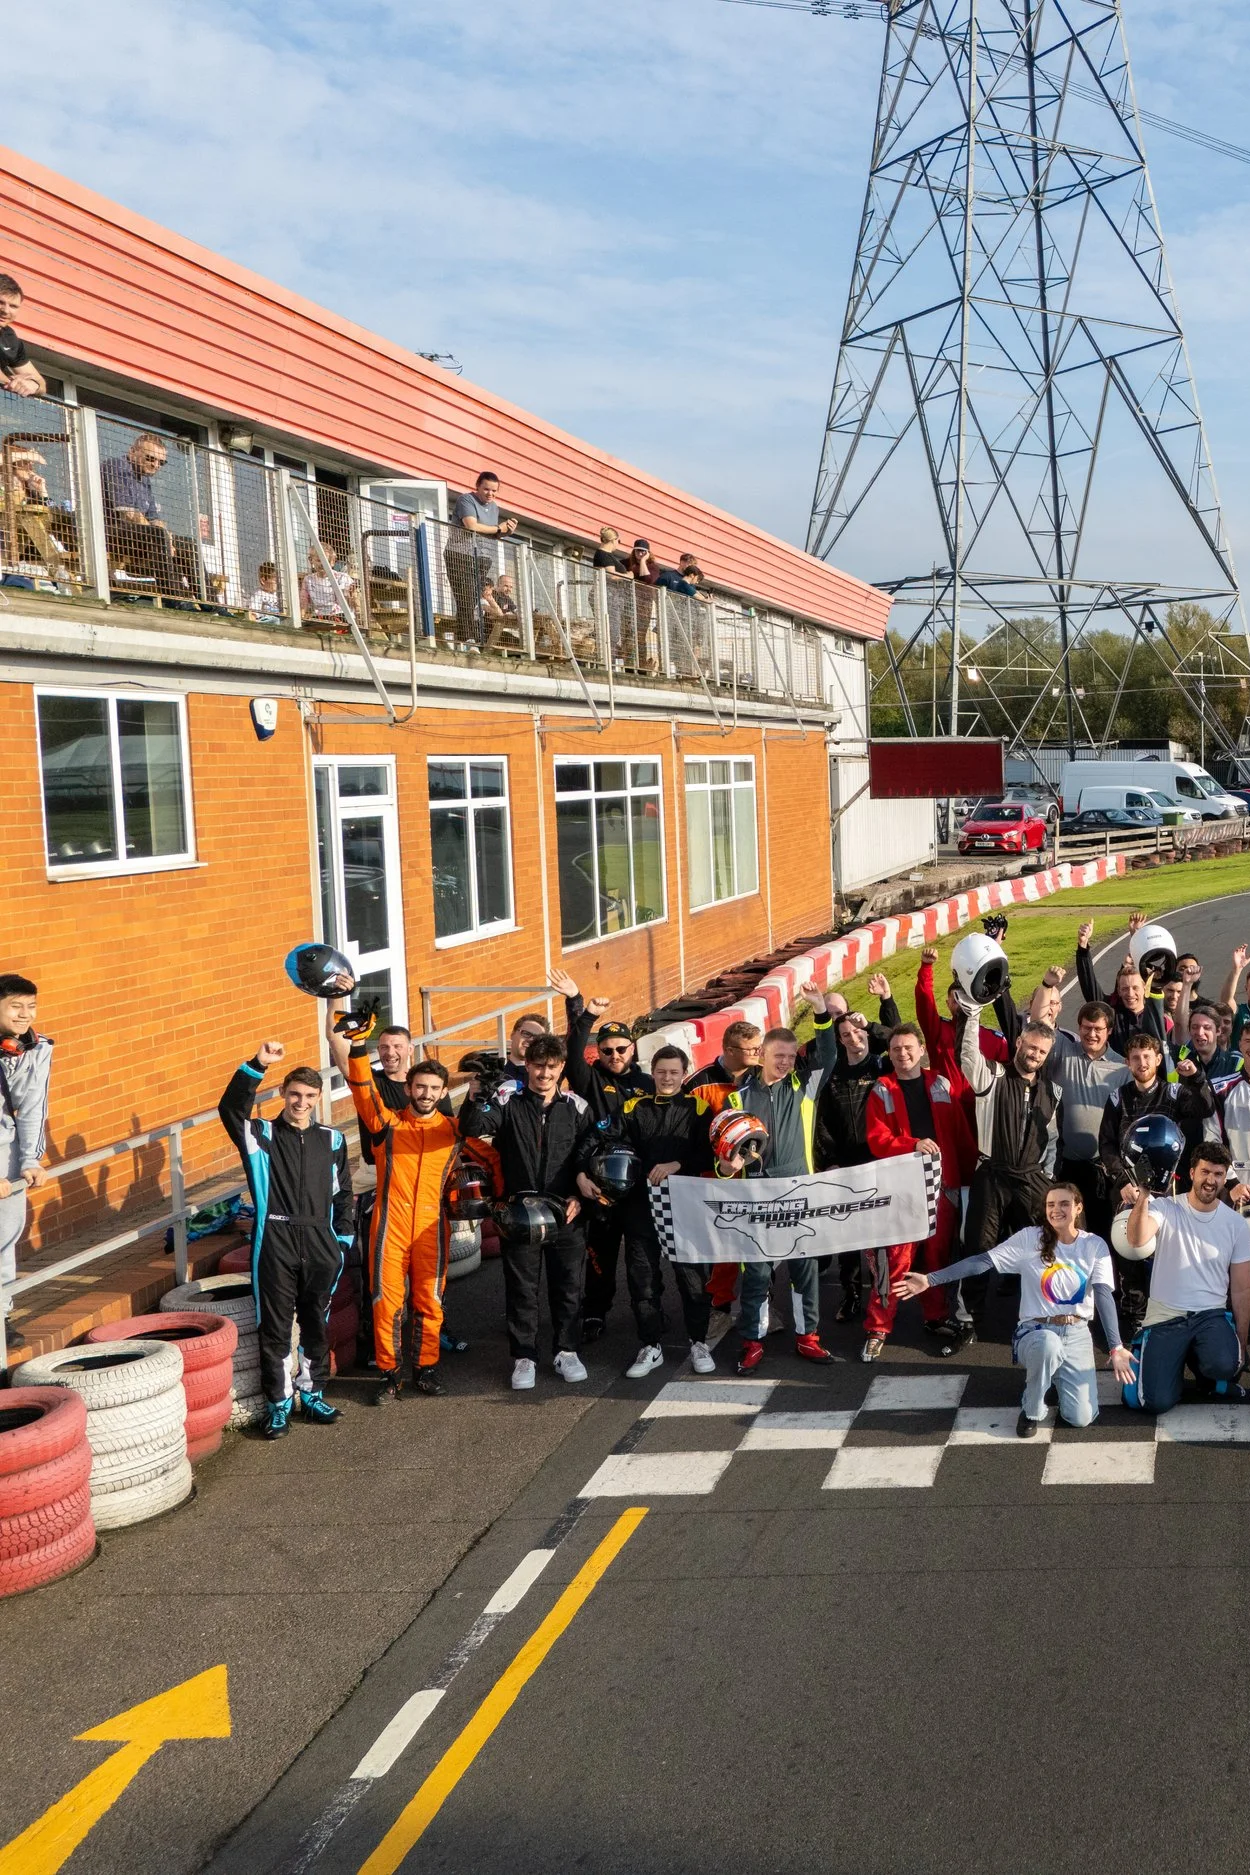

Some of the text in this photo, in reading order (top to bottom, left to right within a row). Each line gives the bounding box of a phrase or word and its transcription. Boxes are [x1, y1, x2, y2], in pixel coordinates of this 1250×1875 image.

[722, 1198, 807, 1213] RACING
[748, 1195, 892, 1224] AWARENESS
[766, 1221, 799, 1229] FOR
